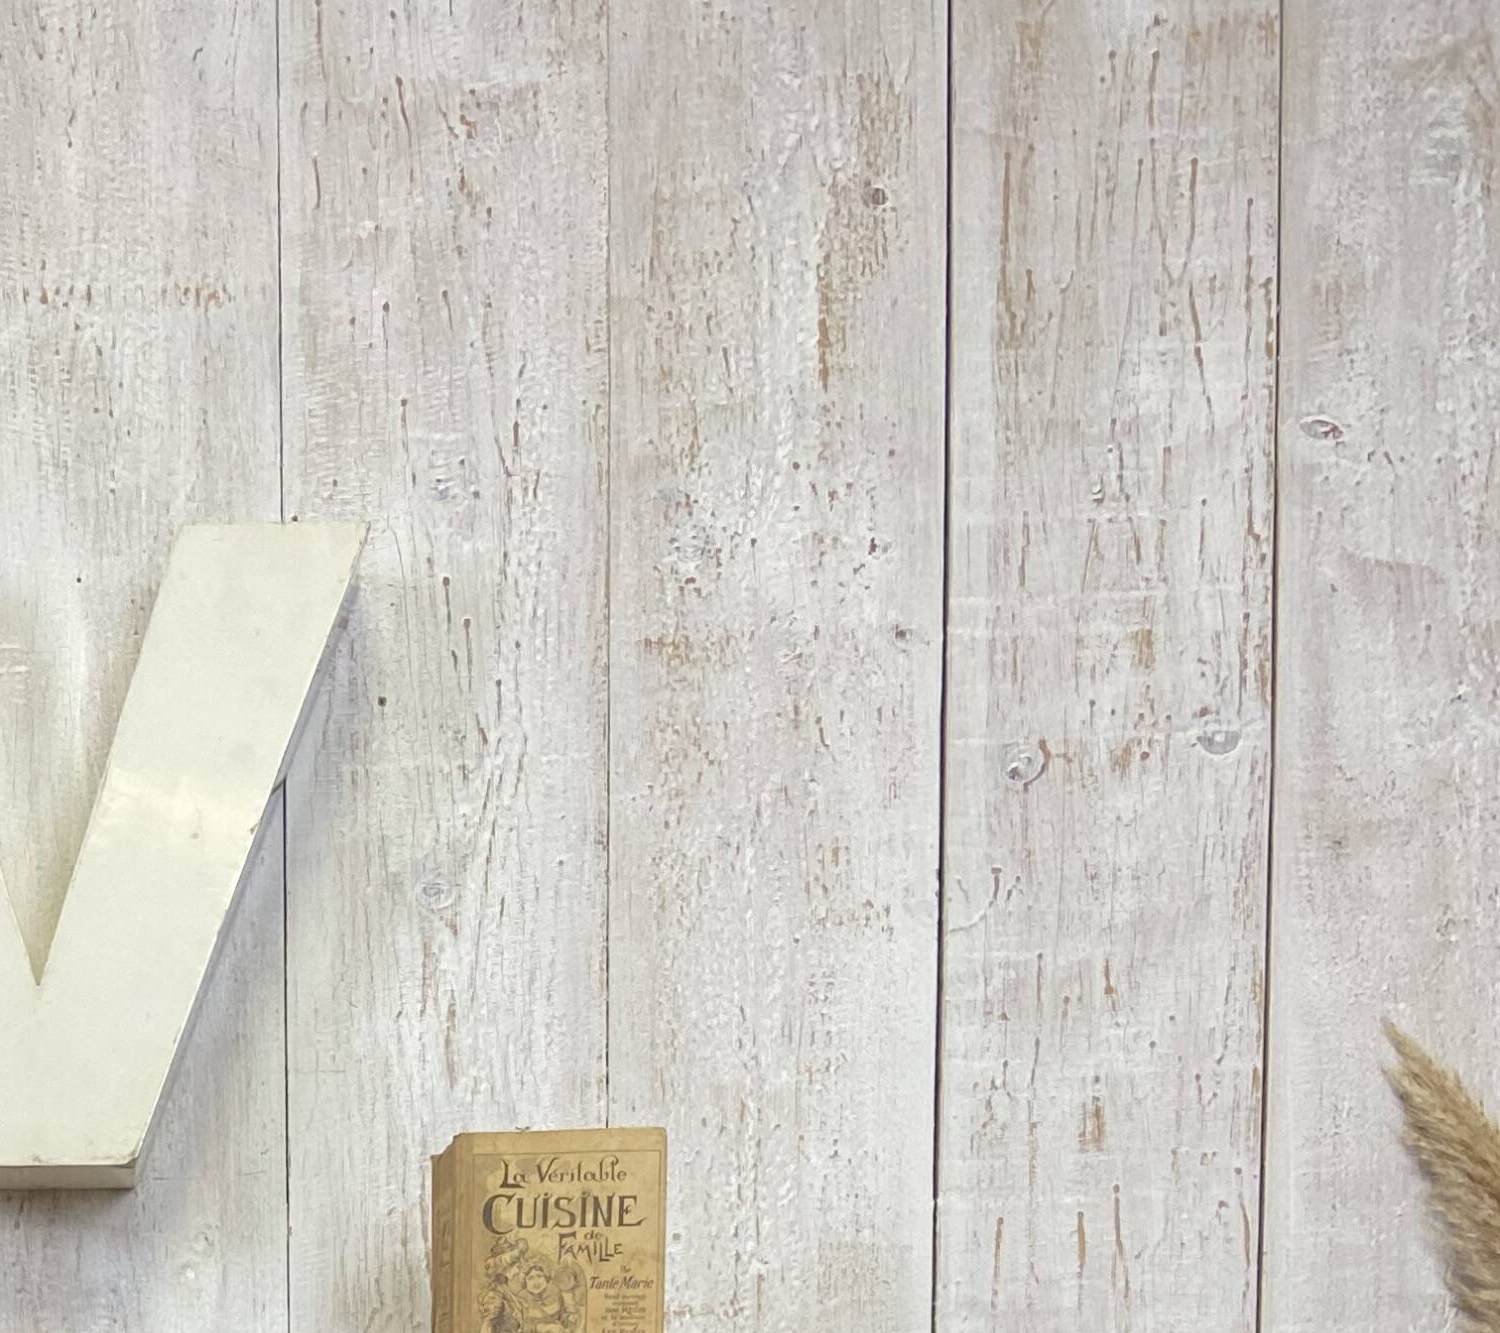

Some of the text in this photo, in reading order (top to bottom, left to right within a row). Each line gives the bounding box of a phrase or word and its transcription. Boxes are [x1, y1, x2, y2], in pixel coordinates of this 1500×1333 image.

[499, 1158, 528, 1189] La
[482, 1190, 648, 1236] CUISINE
[558, 1231, 625, 1265] FAMILLE
[583, 1229, 604, 1241] de
